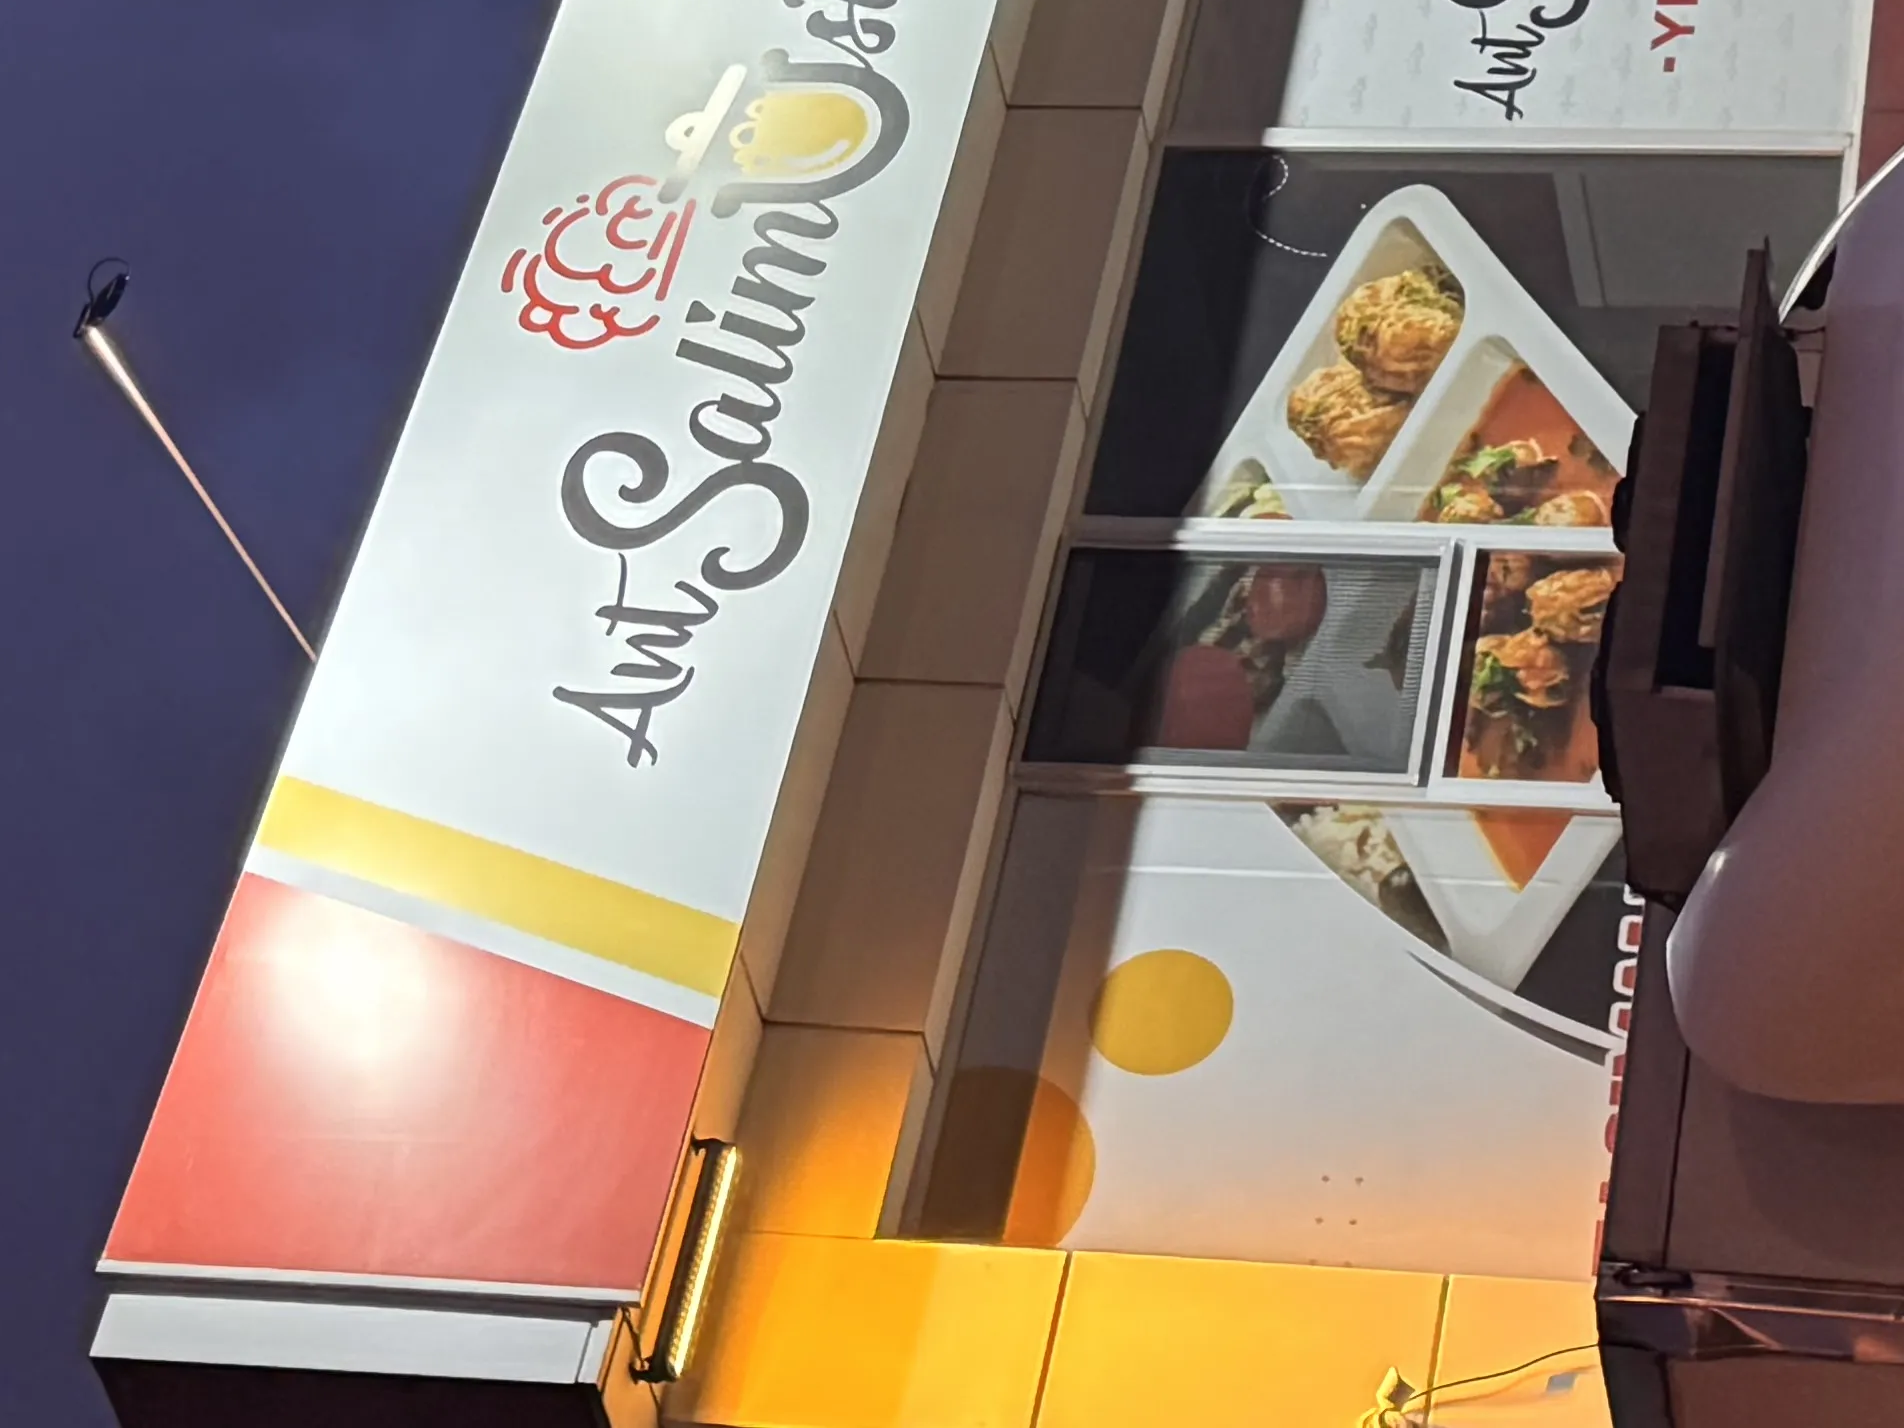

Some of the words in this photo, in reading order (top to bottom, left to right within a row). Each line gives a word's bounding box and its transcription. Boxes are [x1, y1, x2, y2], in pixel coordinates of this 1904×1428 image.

[1454, 10, 1545, 121] Ant
[560, 199, 839, 590] Salim
[552, 555, 718, 767] Ant
